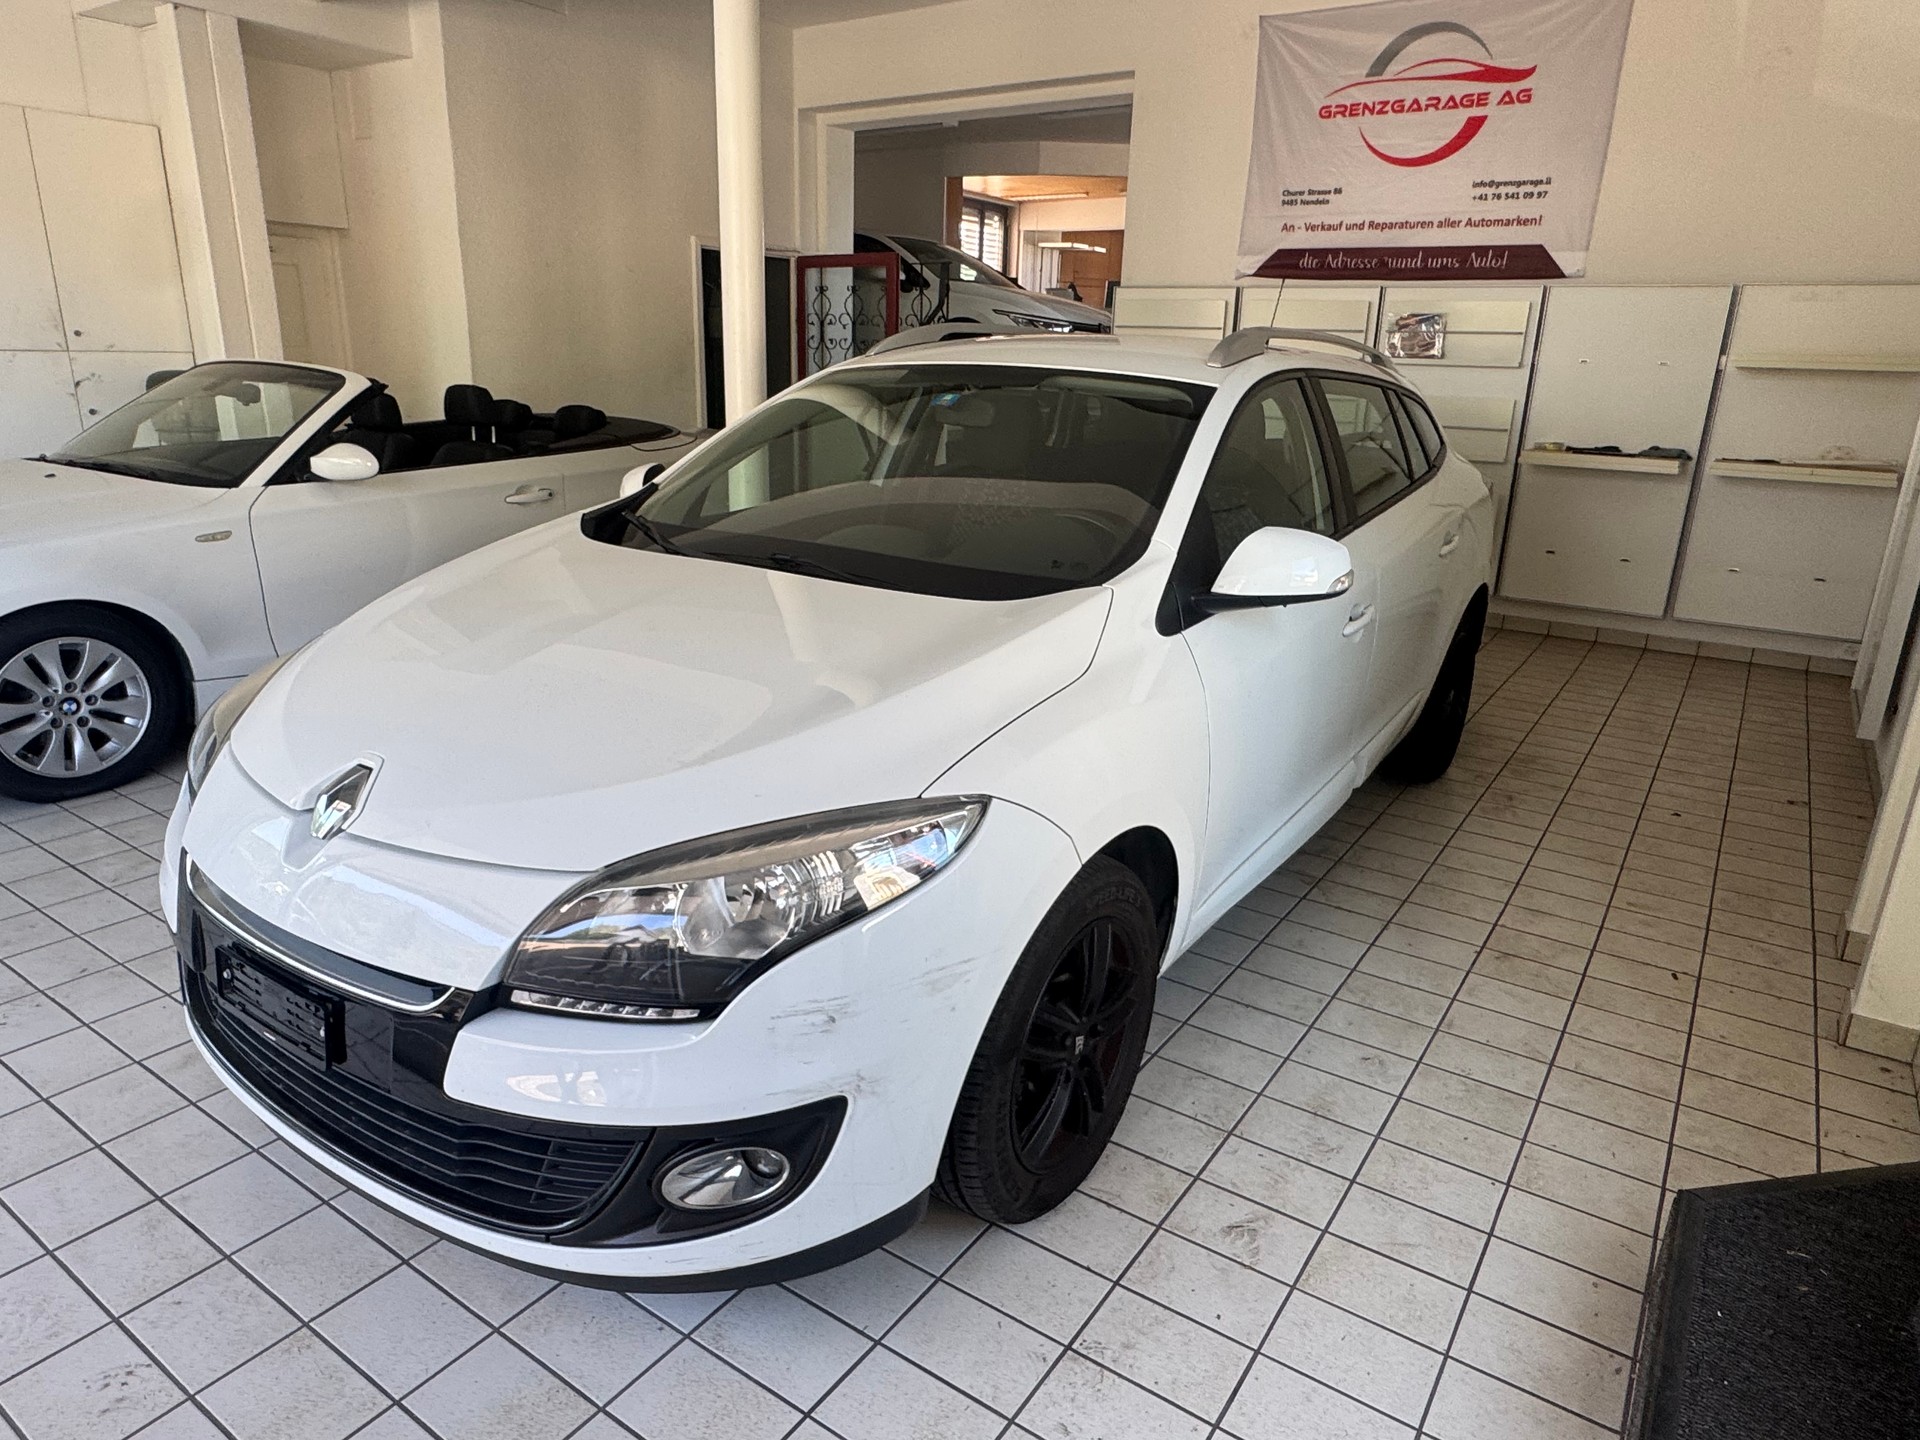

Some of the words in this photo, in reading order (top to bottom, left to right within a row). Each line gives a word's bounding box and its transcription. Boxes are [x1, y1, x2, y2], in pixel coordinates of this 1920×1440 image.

[1318, 92, 1491, 119] GRENZGARAGE
[1496, 88, 1533, 106] AG
[1472, 193, 1488, 201] +41
[1491, 192, 1502, 200] 76
[1504, 191, 1520, 200] 541
[1523, 191, 1535, 199] 09
[1536, 190, 1549, 199] 97
[1281, 222, 1295, 233] An
[1304, 220, 1344, 232] Verkauf
[1345, 219, 1366, 231] und
[1368, 219, 1434, 232] Reparaturen
[1436, 217, 1462, 229] aller
[1464, 214, 1543, 229] Automarken!
[1299, 251, 1321, 269] die
[1325, 251, 1381, 269] Adresse
[1427, 256, 1461, 269] ums
[1466, 249, 1509, 269] Auto!
